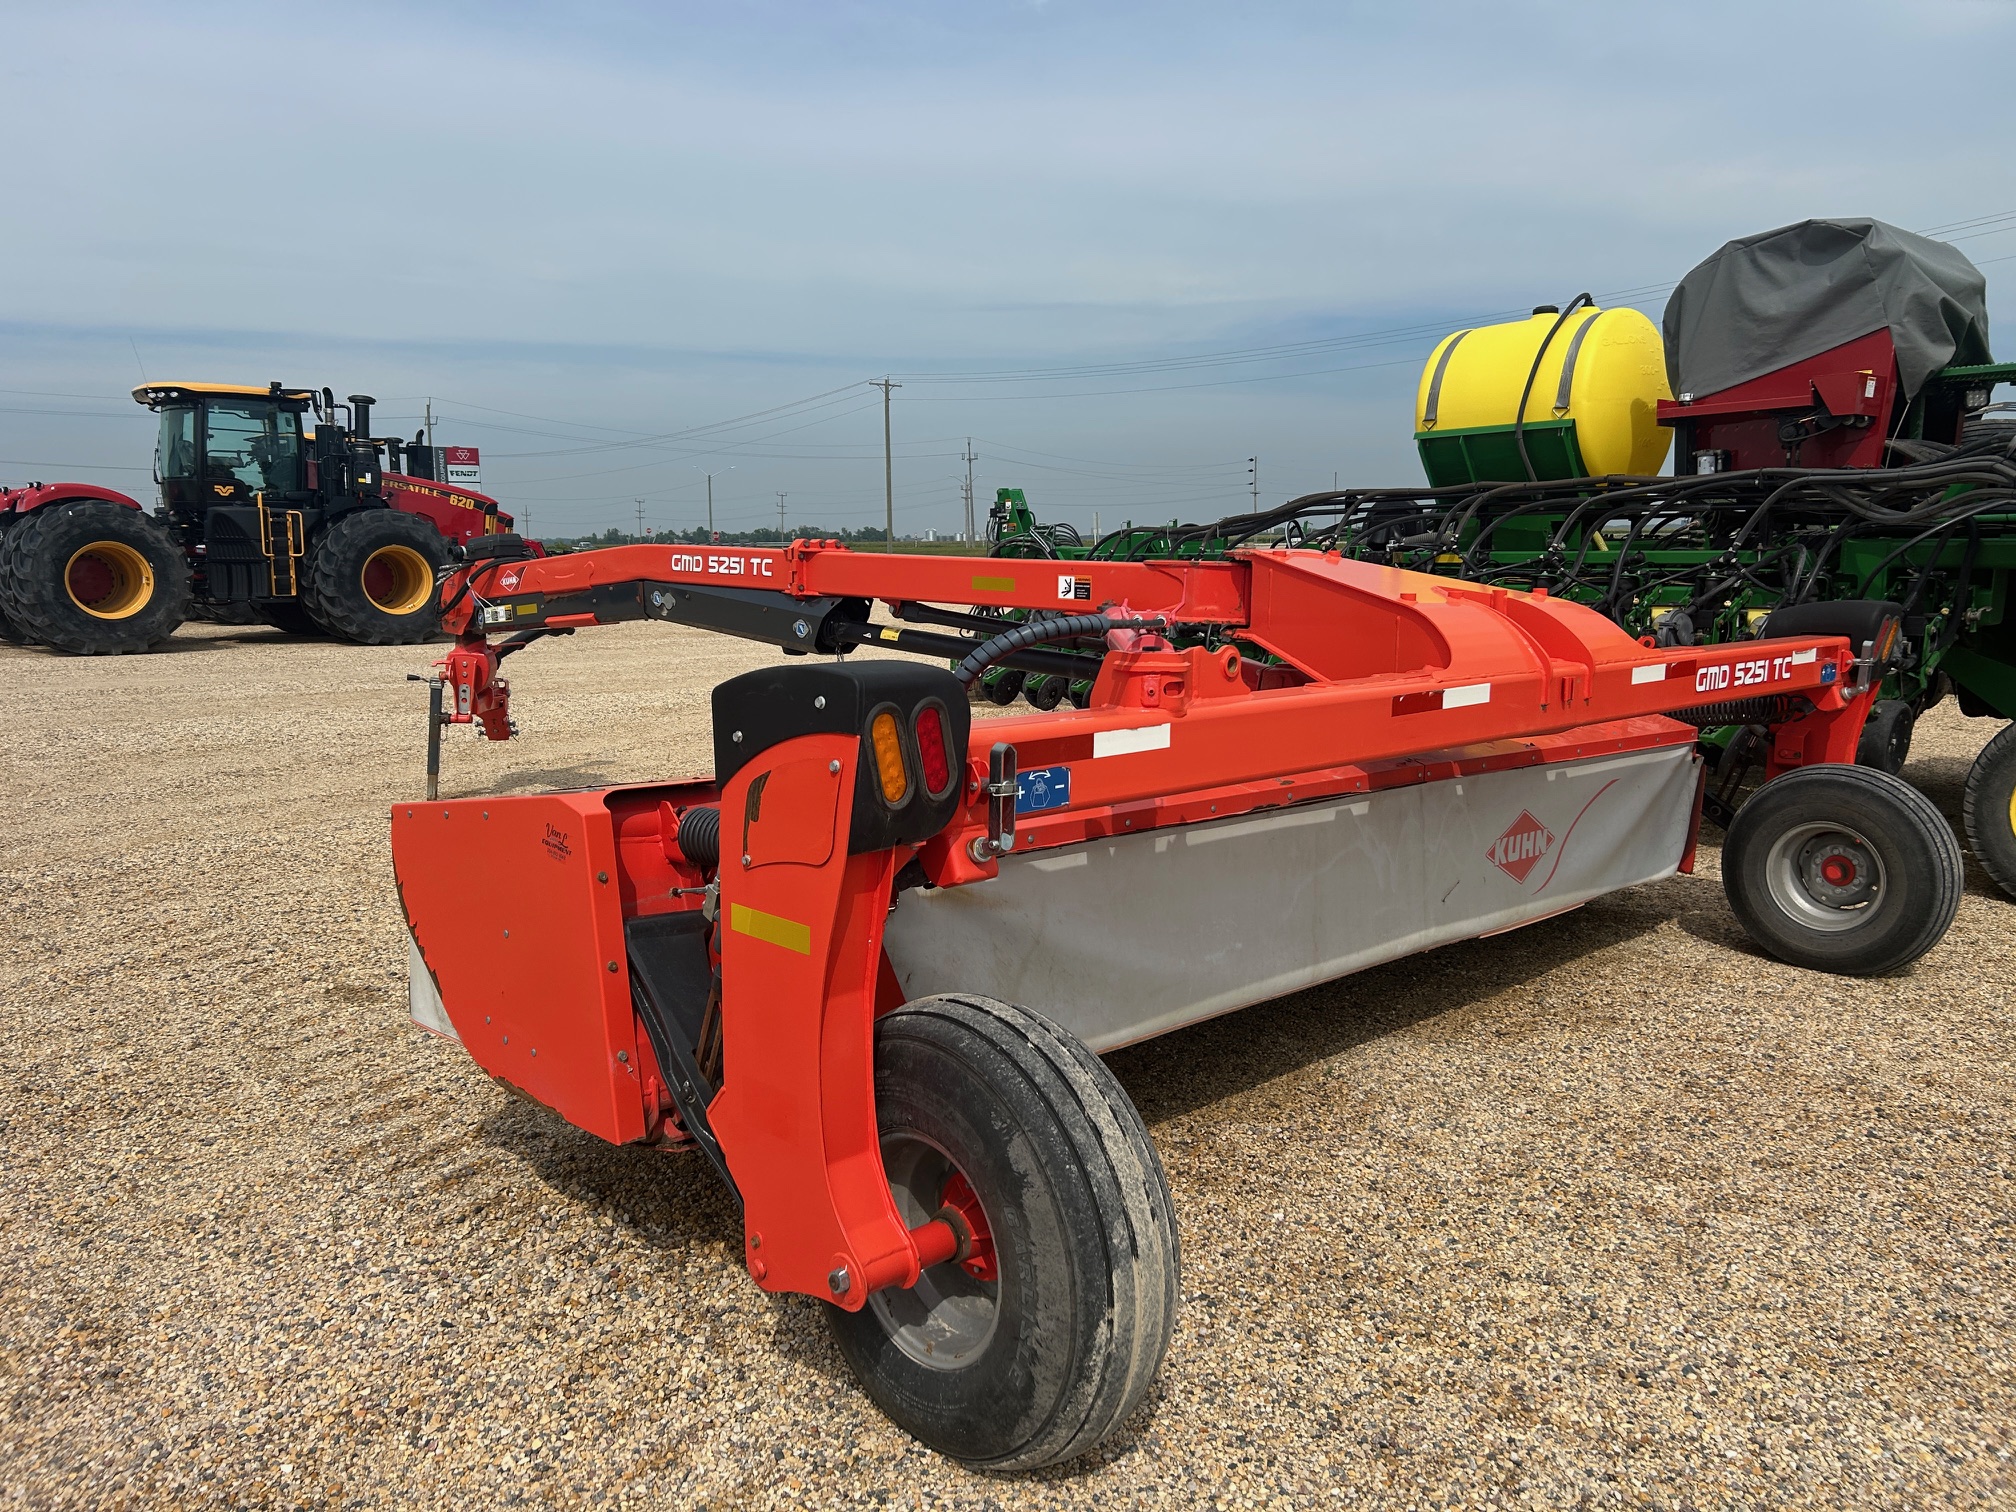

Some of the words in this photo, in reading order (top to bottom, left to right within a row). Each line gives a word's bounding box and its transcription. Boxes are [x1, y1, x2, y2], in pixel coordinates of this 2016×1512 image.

[381, 479, 441, 498] ERSATILE
[449, 494, 475, 510] 620
[671, 554, 703, 572] GMD
[708, 555, 745, 575] 5251
[749, 557, 773, 577] TC
[1696, 665, 1729, 692] GMD
[1734, 660, 1769, 687] 5251
[1773, 657, 1792, 680] TC
[1494, 828, 1548, 866] KUHN
[1003, 1206, 1035, 1387] CARLISLE
